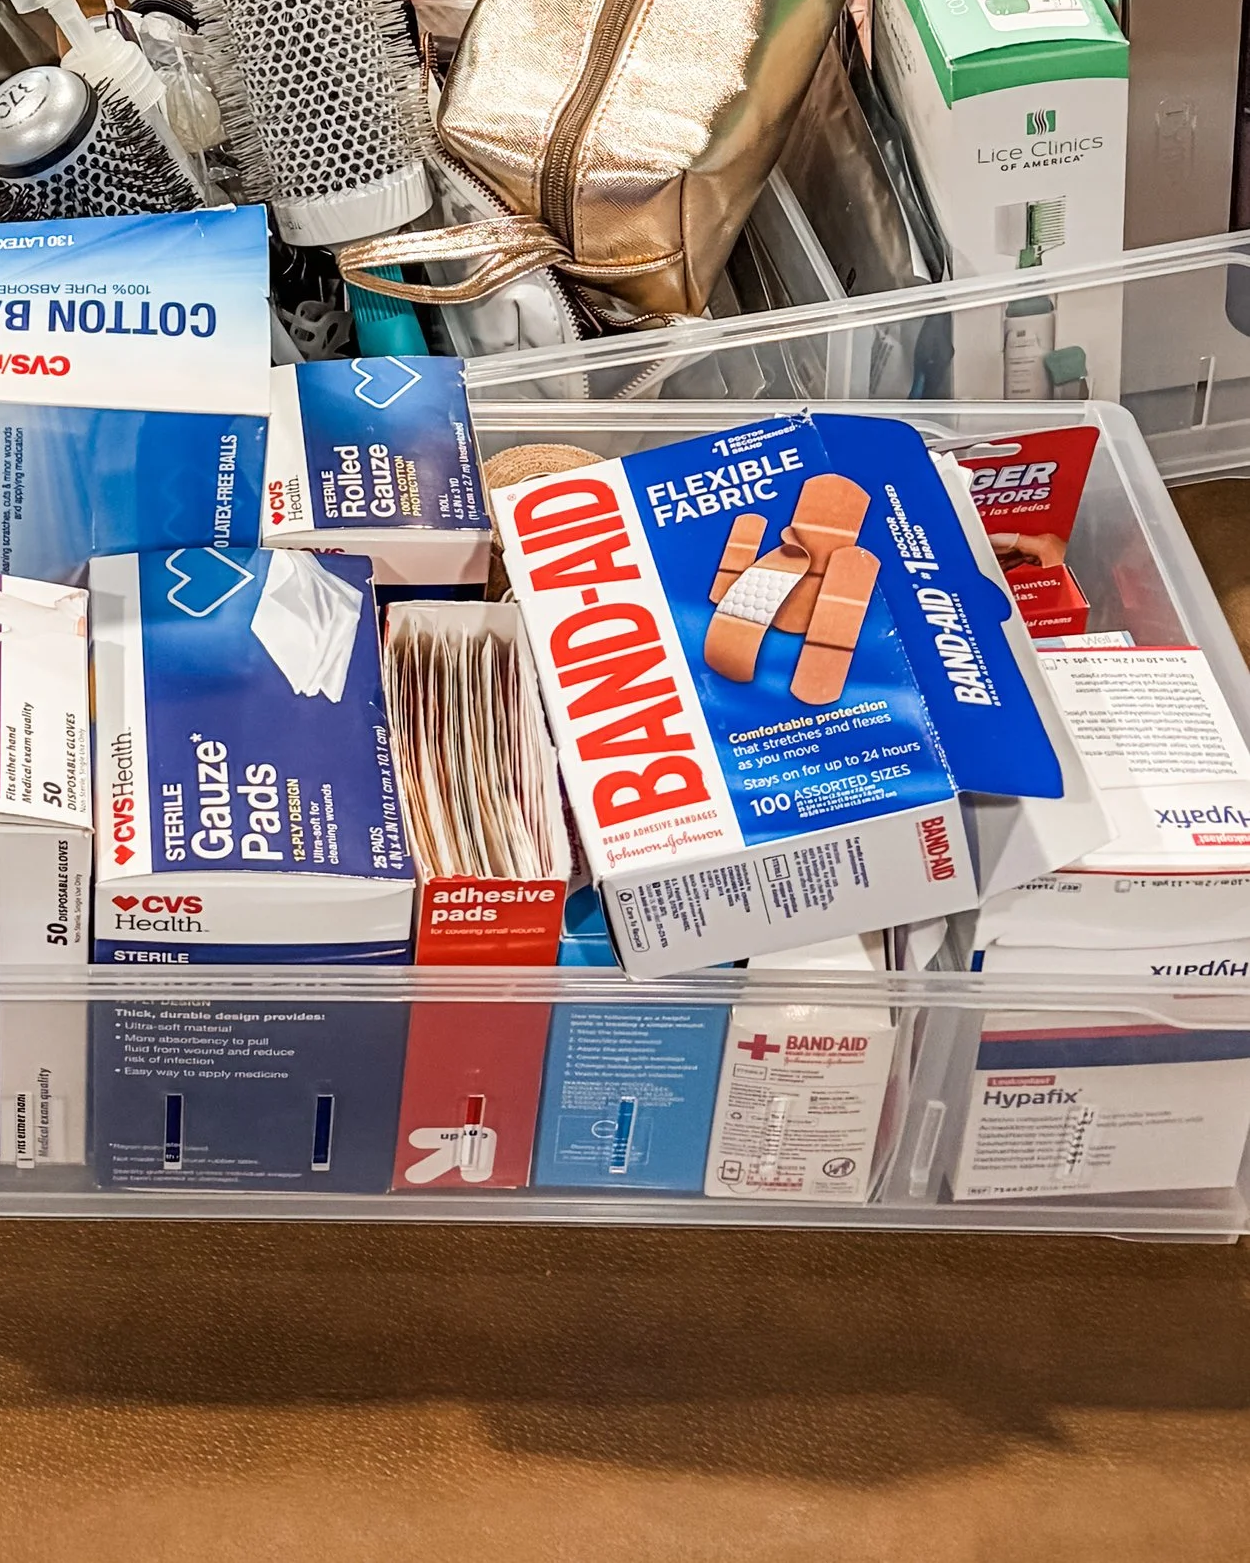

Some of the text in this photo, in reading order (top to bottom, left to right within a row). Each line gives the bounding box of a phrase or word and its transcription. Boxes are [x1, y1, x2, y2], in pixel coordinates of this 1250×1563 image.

[977, 135, 1104, 164] Lice Clinics
[1000, 163, 1018, 171] OF
[47, 234, 75, 247] 130
[63, 284, 106, 295] PURE
[111, 285, 151, 295] 100%
[48, 299, 217, 337] COTTON
[333, 445, 367, 518] Rolled
[368, 443, 396, 518] Gauze
[645, 448, 805, 508] FLEXIBLE
[269, 480, 286, 511] CVS
[320, 470, 339, 518] STERILE
[651, 482, 779, 529] FABRIC
[1011, 503, 1051, 514] dedos
[1012, 578, 1061, 591] puntos,
[1039, 617, 1072, 626] creams
[513, 478, 713, 831] BAND-AID
[916, 587, 992, 706] BAND-AID
[728, 699, 888, 744] Comfortable protection
[733, 712, 892, 758] that stretches and flexes
[66, 713, 77, 811] DISPOSABLE GLOVES
[43, 781, 62, 808] 50
[750, 793, 791, 817] 100
[793, 774, 868, 801] ASSORTED
[870, 764, 912, 783] SIZES
[162, 783, 186, 862] STERILE
[236, 763, 283, 861] Pads
[920, 815, 956, 882] BAND-AID
[47, 840, 69, 946] 50 DISPOSABLE GLOVES
[141, 895, 203, 914] CVS
[433, 887, 555, 904] adhesive
[431, 906, 498, 925] pads
[113, 950, 189, 964] STERILE
[114, 1008, 326, 1024] Thick, durable design provides:
[124, 1022, 232, 1033] Ultra-soft material
[786, 1035, 868, 1052] BAND-AID
[983, 1089, 1079, 1108] Hypafix
